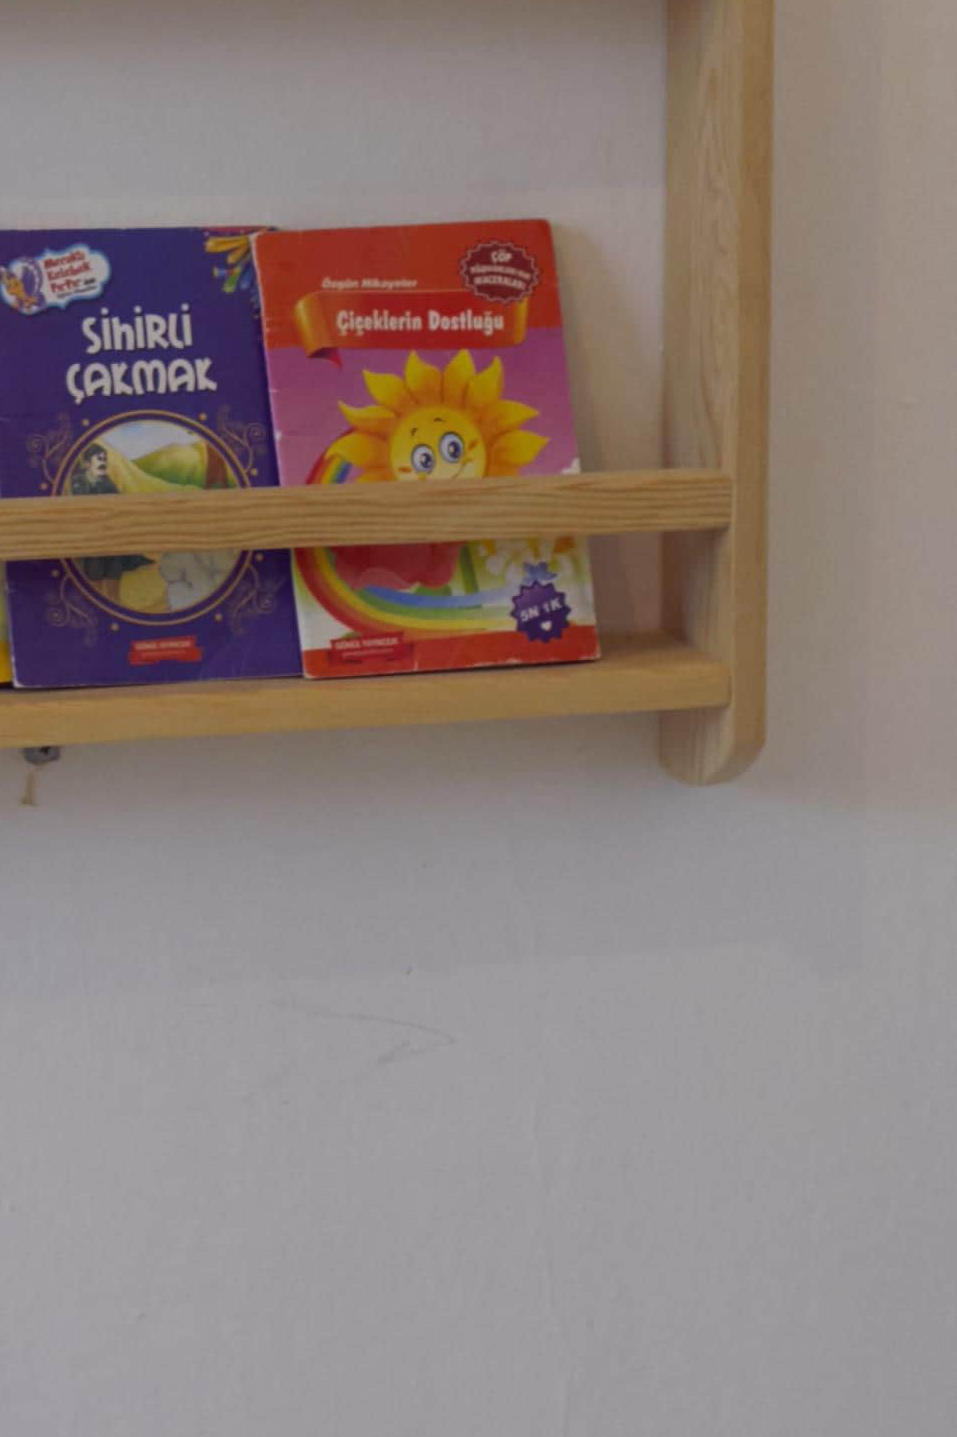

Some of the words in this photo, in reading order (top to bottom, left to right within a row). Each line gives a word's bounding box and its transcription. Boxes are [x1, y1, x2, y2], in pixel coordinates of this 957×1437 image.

[491, 248, 513, 265] ÇÖP
[336, 310, 422, 336] Çiçeklerin
[428, 310, 504, 336] Dostluğu
[66, 357, 218, 405] ÇAKMAK
